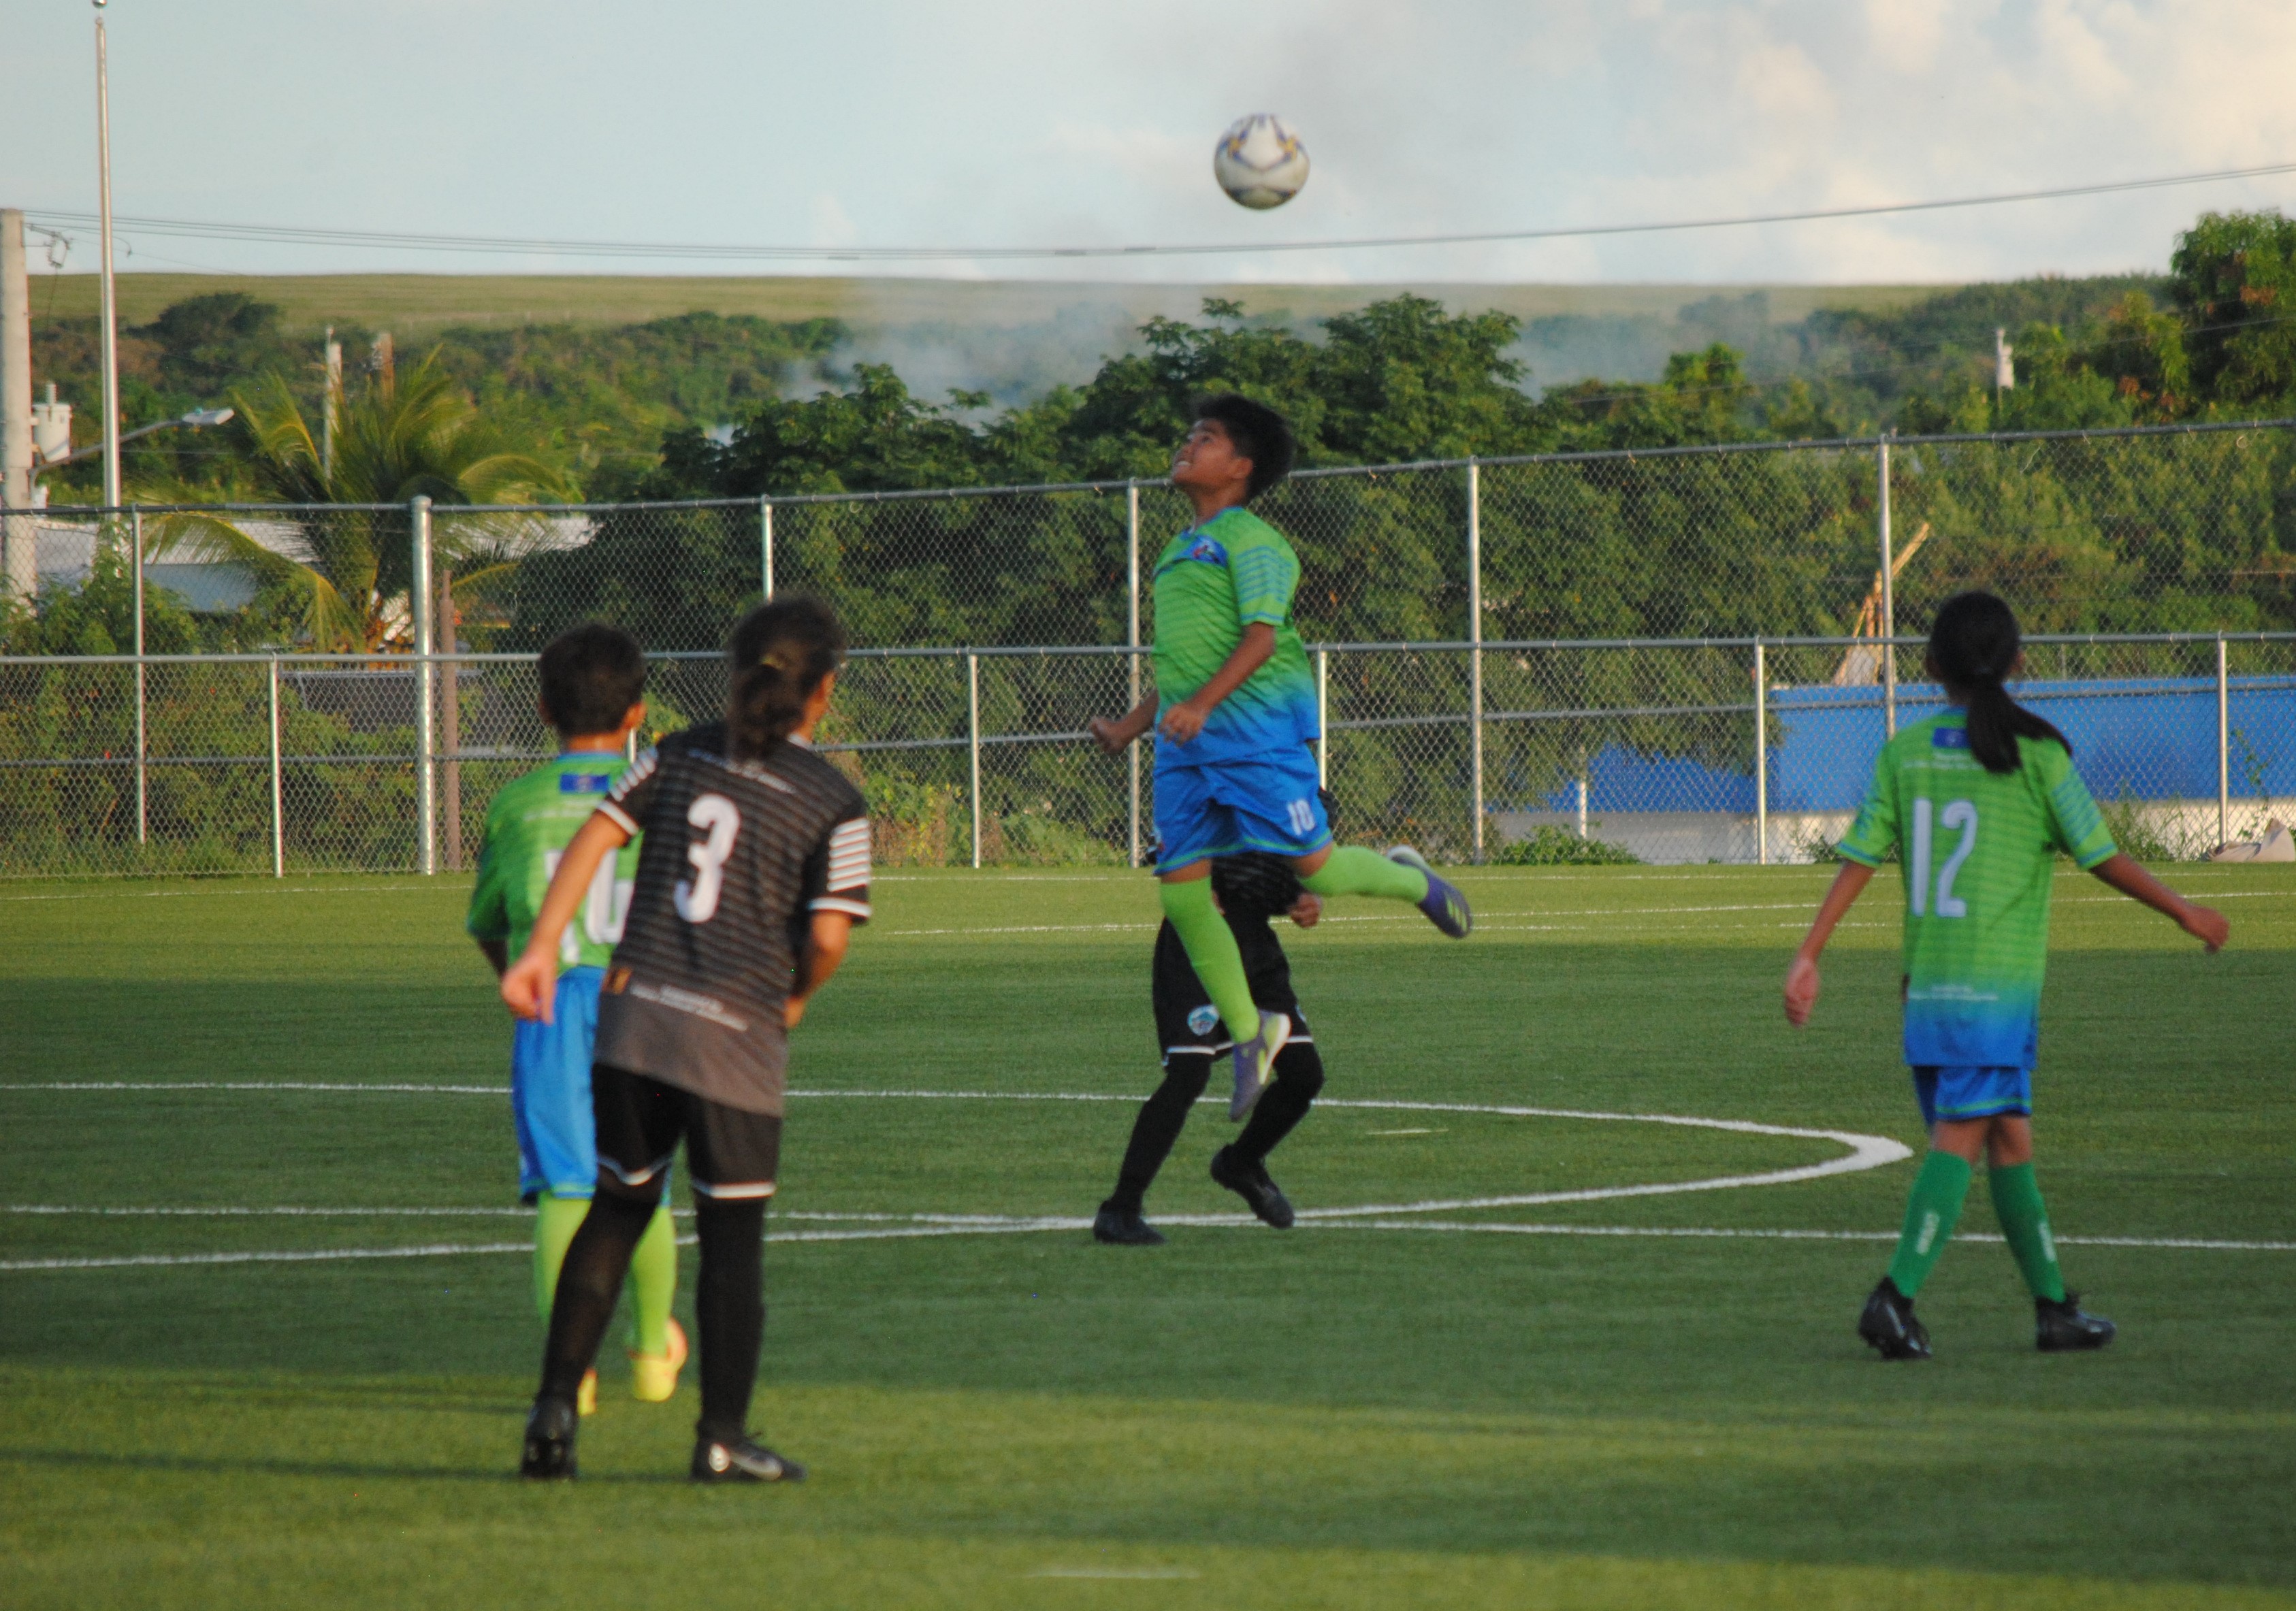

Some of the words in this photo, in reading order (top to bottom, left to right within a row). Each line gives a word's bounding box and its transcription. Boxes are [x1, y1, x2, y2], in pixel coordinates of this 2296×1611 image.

[674, 794, 741, 923] 3
[1287, 799, 1315, 836] 10
[1910, 798, 1977, 917] 12
